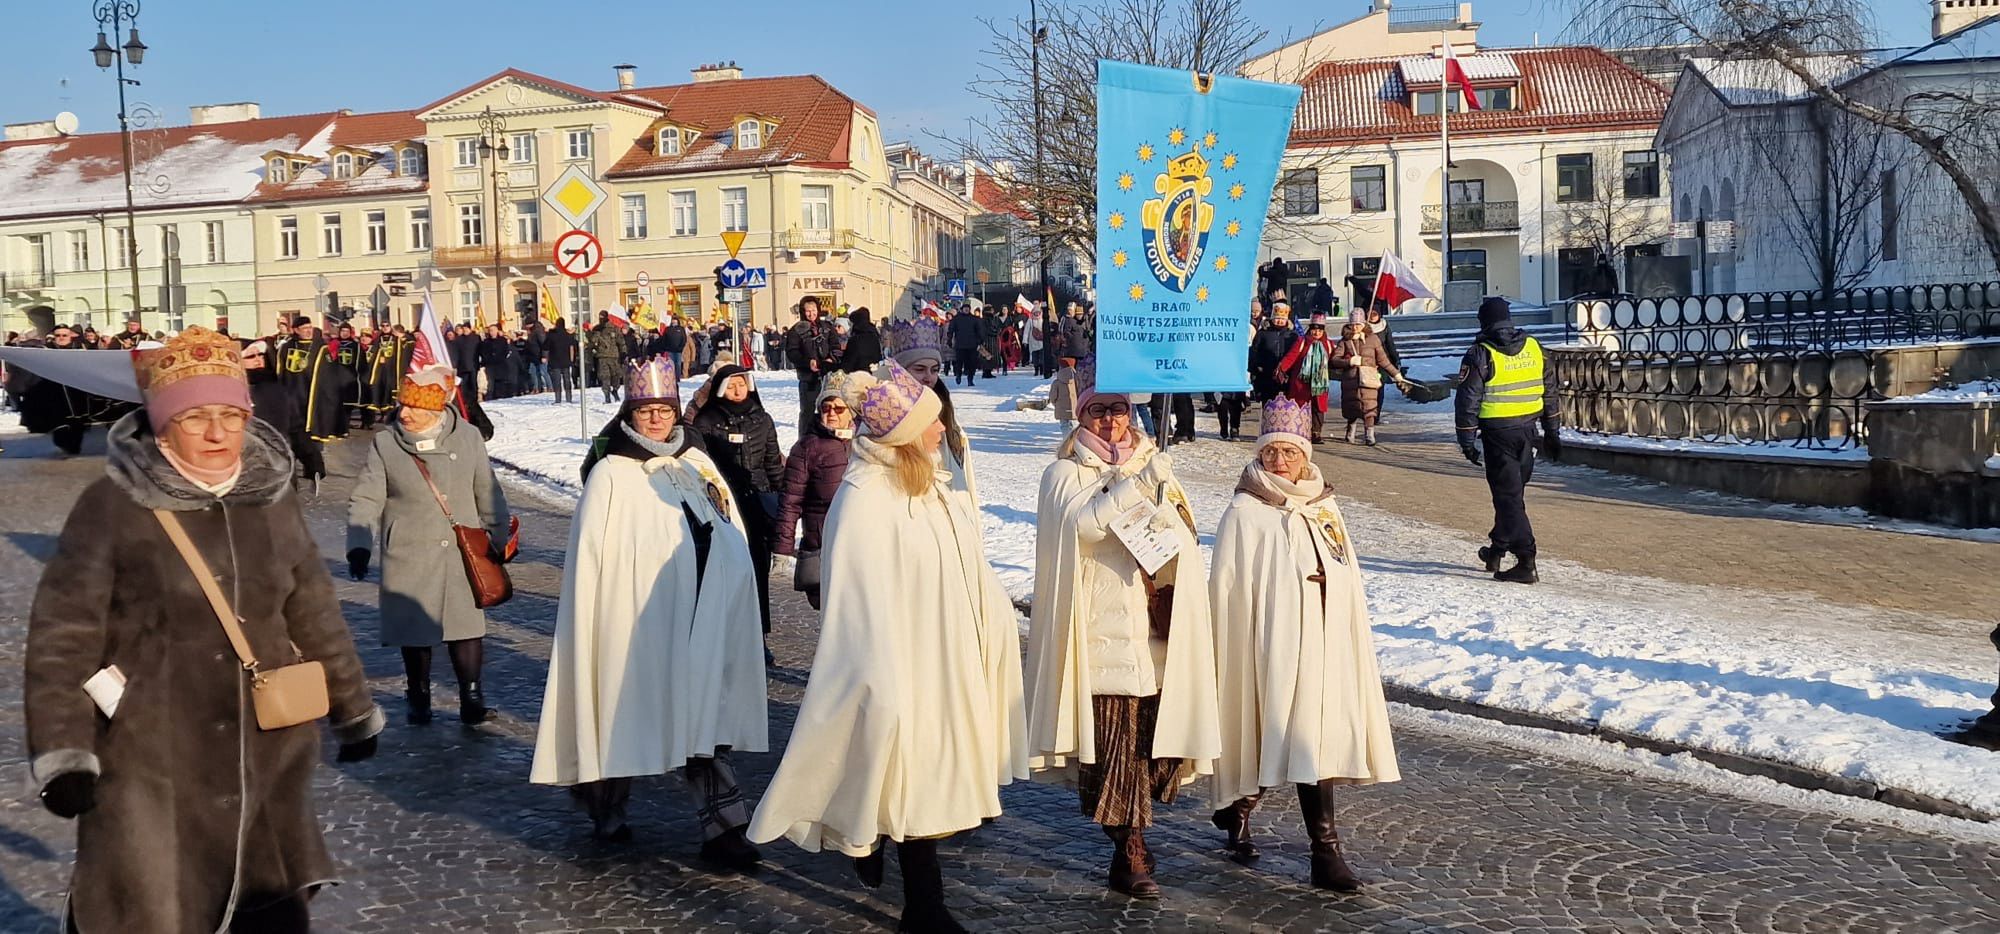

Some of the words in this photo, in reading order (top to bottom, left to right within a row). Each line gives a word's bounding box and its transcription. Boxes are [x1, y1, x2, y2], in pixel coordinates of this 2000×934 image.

[1146, 240, 1170, 282] TOTUS
[1205, 317, 1239, 328] PANNY
[1102, 328, 1164, 343] KRÓLOWEJ
[1198, 332, 1235, 342] POLSKI
